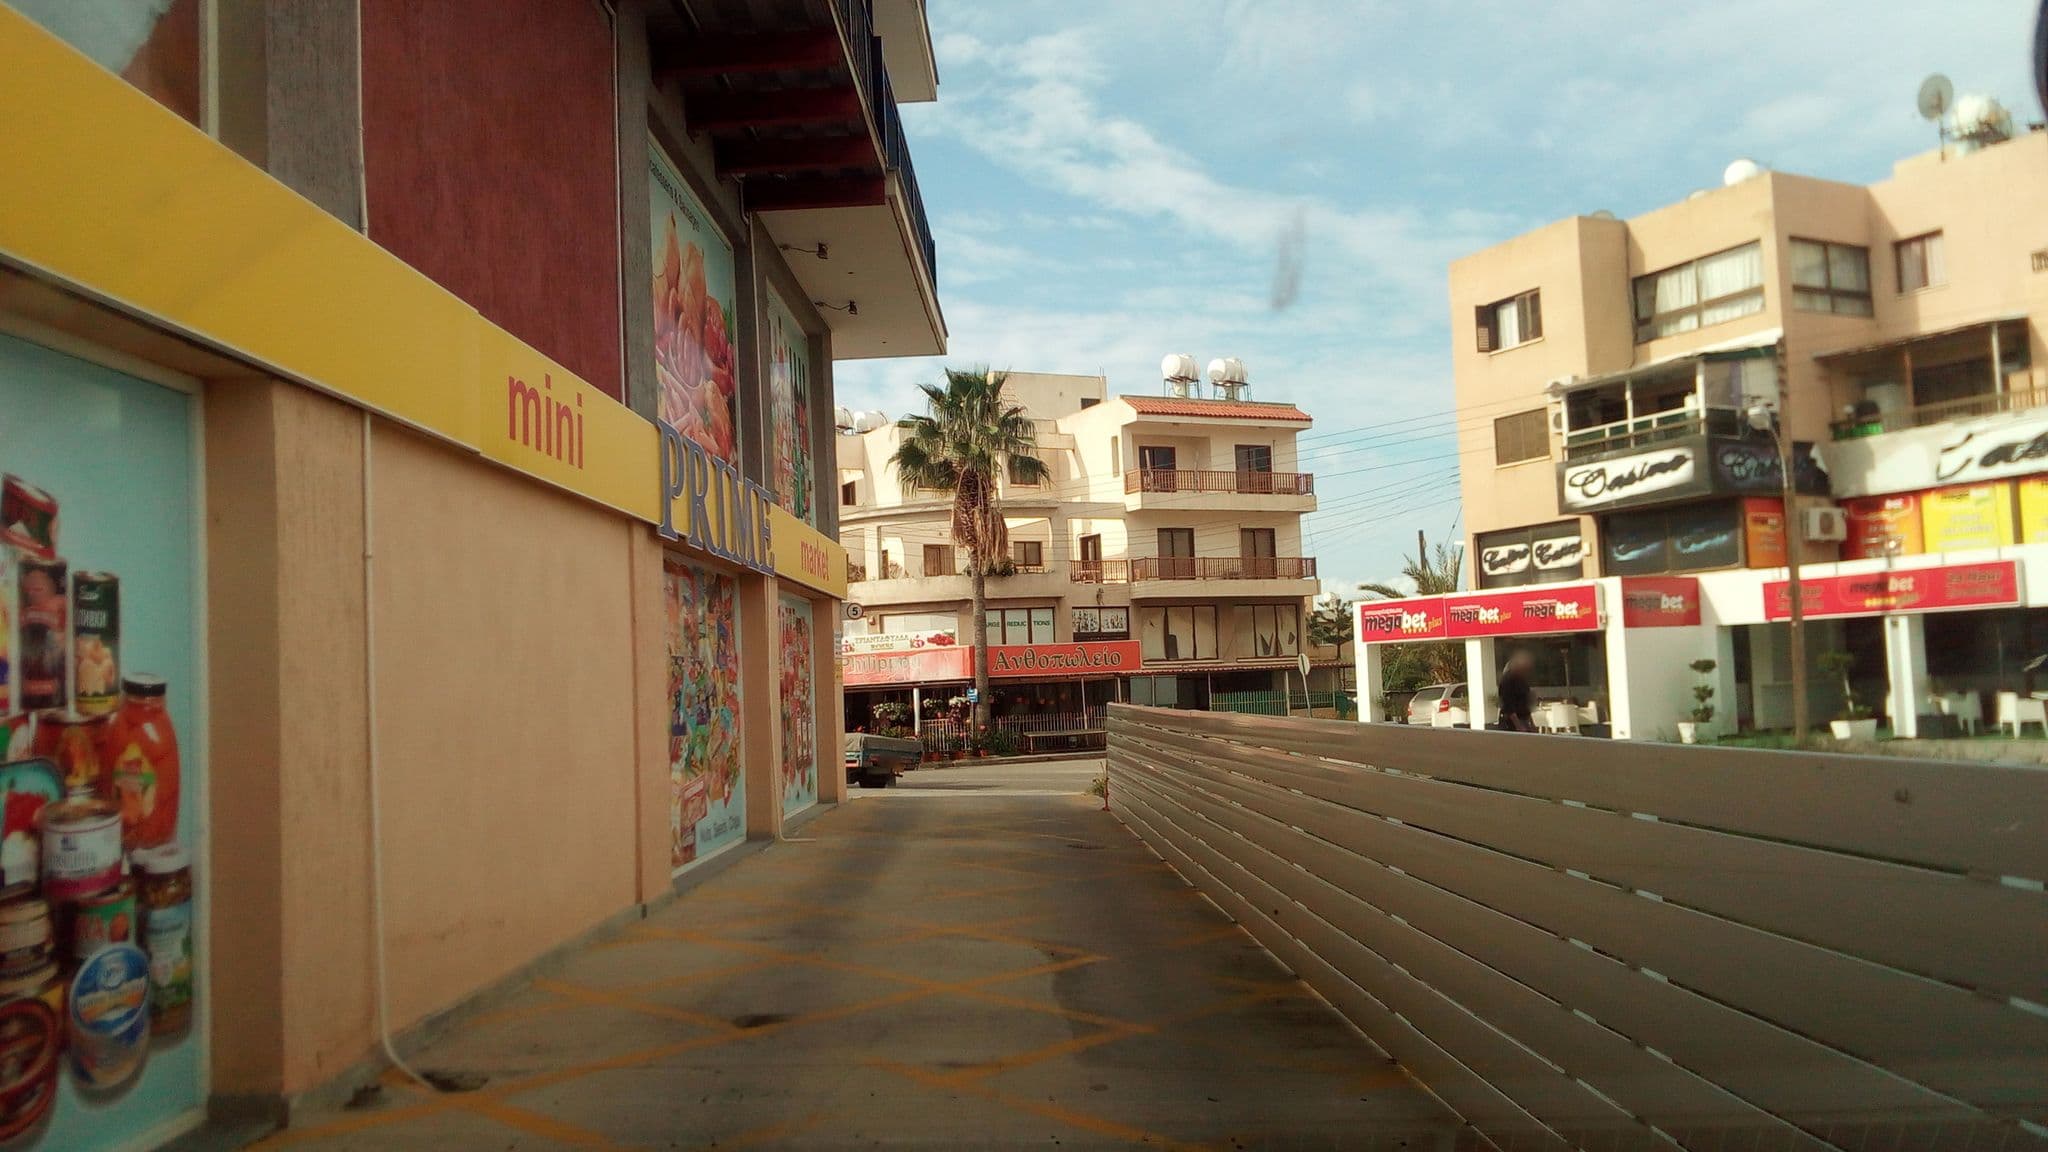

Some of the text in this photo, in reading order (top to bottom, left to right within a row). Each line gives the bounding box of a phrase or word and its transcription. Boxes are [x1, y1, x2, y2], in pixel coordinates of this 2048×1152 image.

[507, 373, 585, 471] mini
[1568, 454, 1690, 498] Casino
[656, 420, 776, 578] PRIME
[800, 537, 831, 582] market
[852, 606, 859, 616] 5
[993, 646, 1122, 672] Ανθοπωλείο
